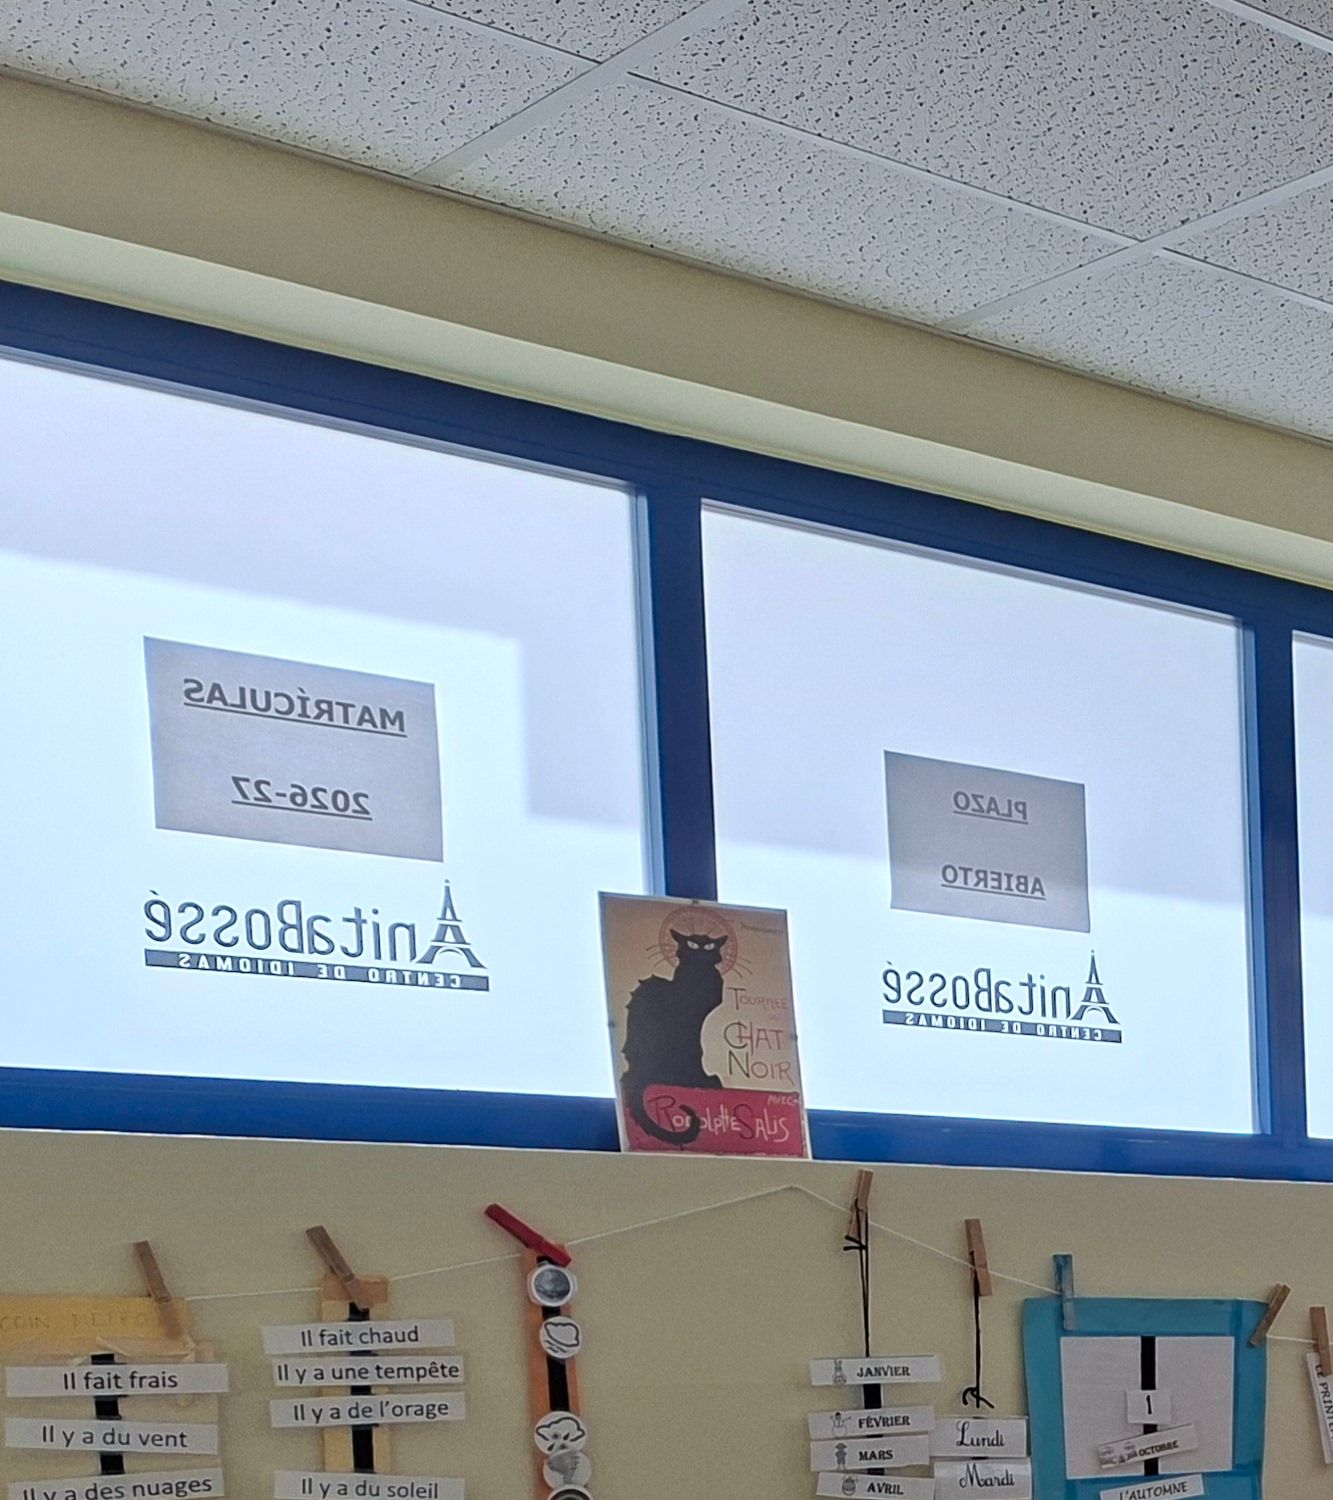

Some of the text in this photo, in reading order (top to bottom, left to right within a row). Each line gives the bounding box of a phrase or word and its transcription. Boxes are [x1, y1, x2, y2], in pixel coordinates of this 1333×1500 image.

[723, 1021, 785, 1060] CHAT
[728, 1051, 794, 1085] NOIR
[301, 1325, 419, 1347] Il fait chaud
[64, 1371, 178, 1390] Il fait frais
[278, 1361, 460, 1384] Il y a une tempête
[857, 1365, 910, 1377] JANVIER
[294, 1400, 449, 1424] Il y a de l'orage
[858, 1414, 911, 1429] FÉVRIER
[43, 1425, 188, 1448] Il y a du vent
[956, 1421, 1005, 1447] Lundi
[859, 1450, 893, 1461] MARS
[1138, 1440, 1179, 1457] OCTOBRE
[959, 1462, 1015, 1488] Mardi
[85, 1483, 125, 1500] des
[132, 1479, 212, 1498] nuages
[302, 1478, 438, 1499] Il y a du soleil
[867, 1482, 904, 1495] AVRIL
